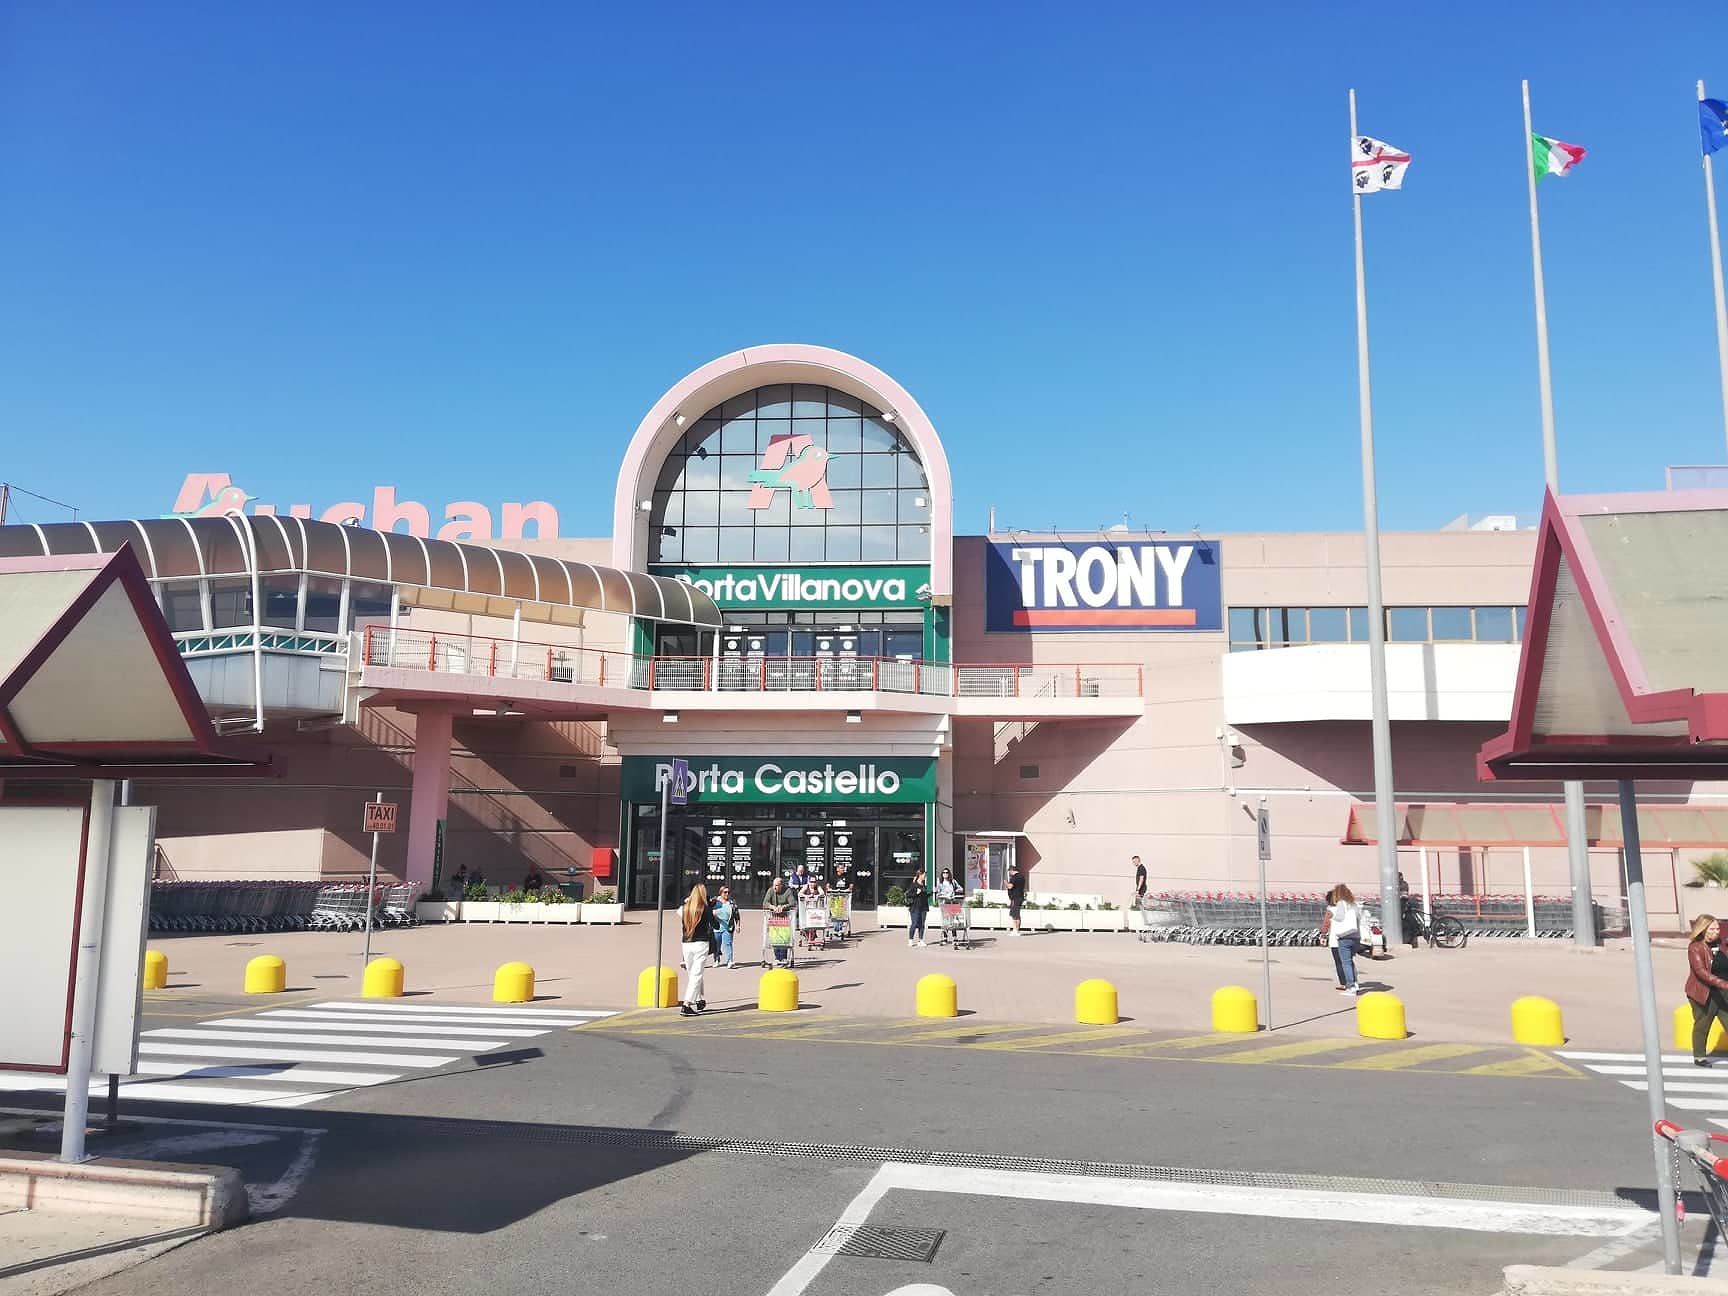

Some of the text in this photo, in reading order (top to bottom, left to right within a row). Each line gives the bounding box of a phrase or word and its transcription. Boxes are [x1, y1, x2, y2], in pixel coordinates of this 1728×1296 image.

[1012, 546, 1194, 608] TRONY
[754, 763, 900, 794] Castello
[368, 806, 395, 821] TAXI
